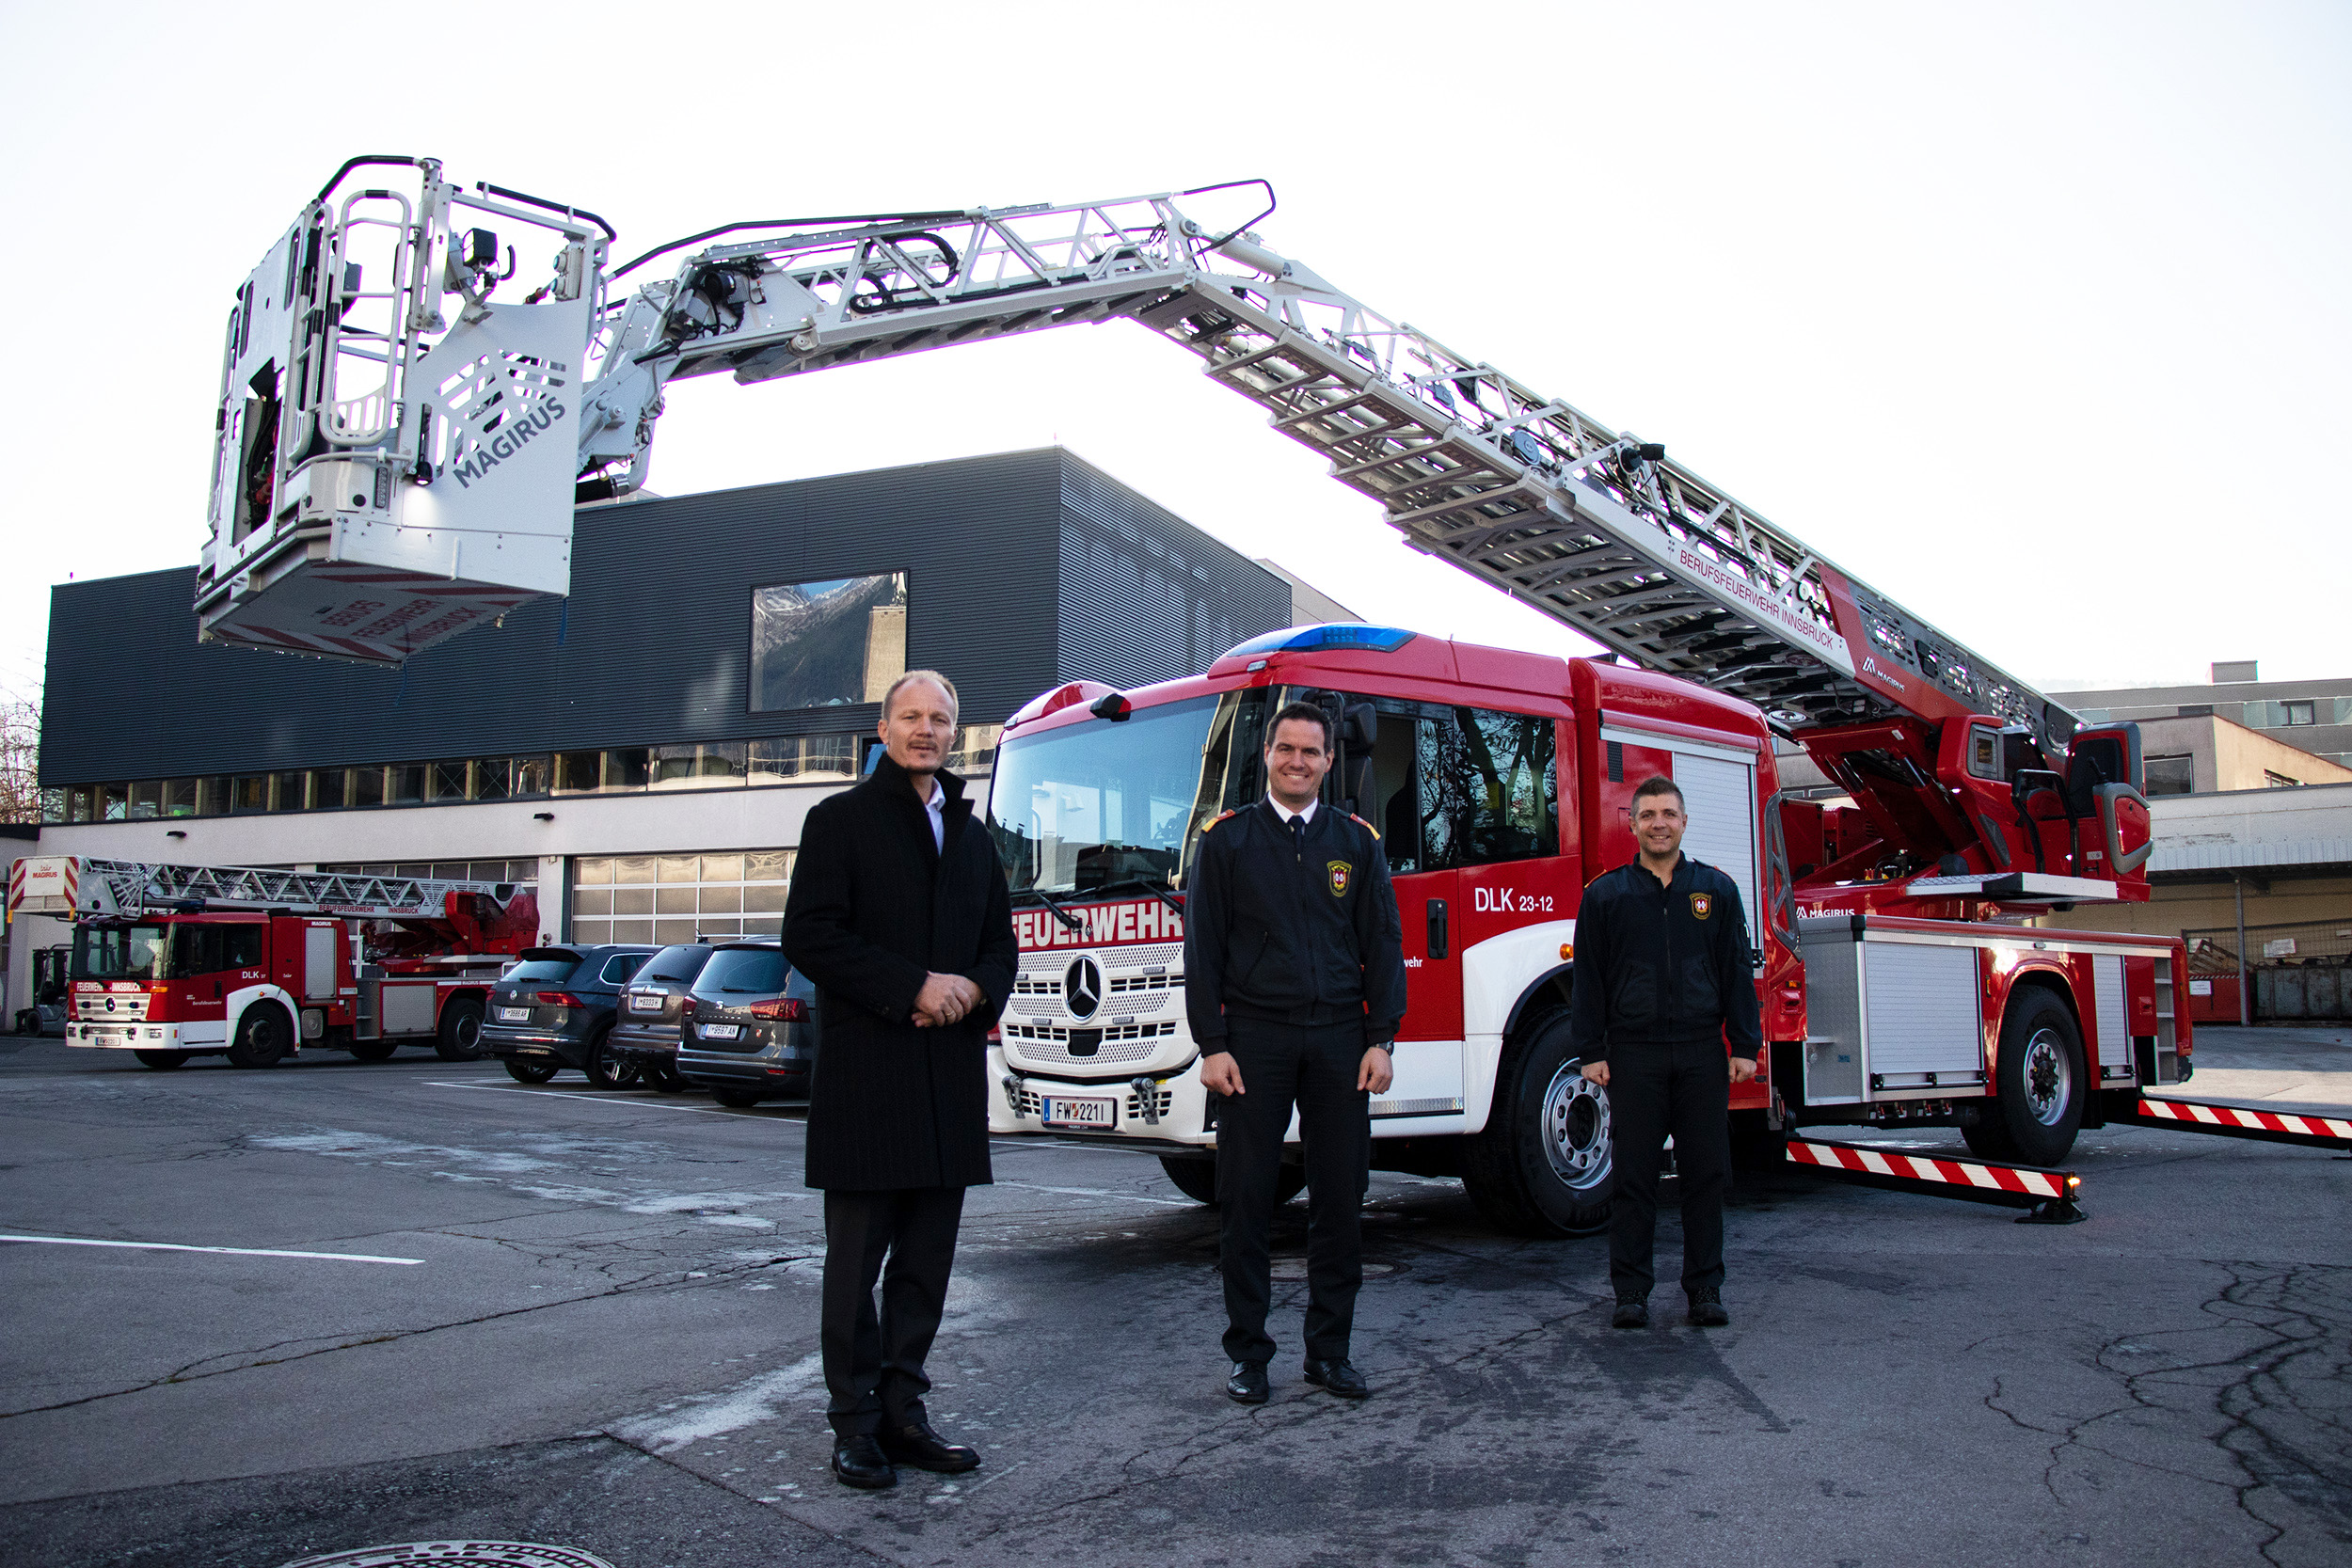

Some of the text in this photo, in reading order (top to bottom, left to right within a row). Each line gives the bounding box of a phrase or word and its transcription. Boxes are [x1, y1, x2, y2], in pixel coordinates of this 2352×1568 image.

[453, 396, 565, 489] MAGIRUS
[1680, 549, 1834, 650] BERUFSFEUERWEHR INNSBRUCK
[320, 600, 386, 626] BERUFS
[351, 598, 445, 638] FEUERWEHR
[1877, 669, 1906, 694] MAGIRUS
[319, 904, 374, 913] BERUFSFEUERWEHR
[1474, 887, 1553, 911] DLK 23-12
[1809, 908, 1855, 919] MAGIRUS
[1404, 956, 1423, 968] wehr
[242, 971, 260, 979] DLK
[1057, 1102, 1072, 1119] FW
